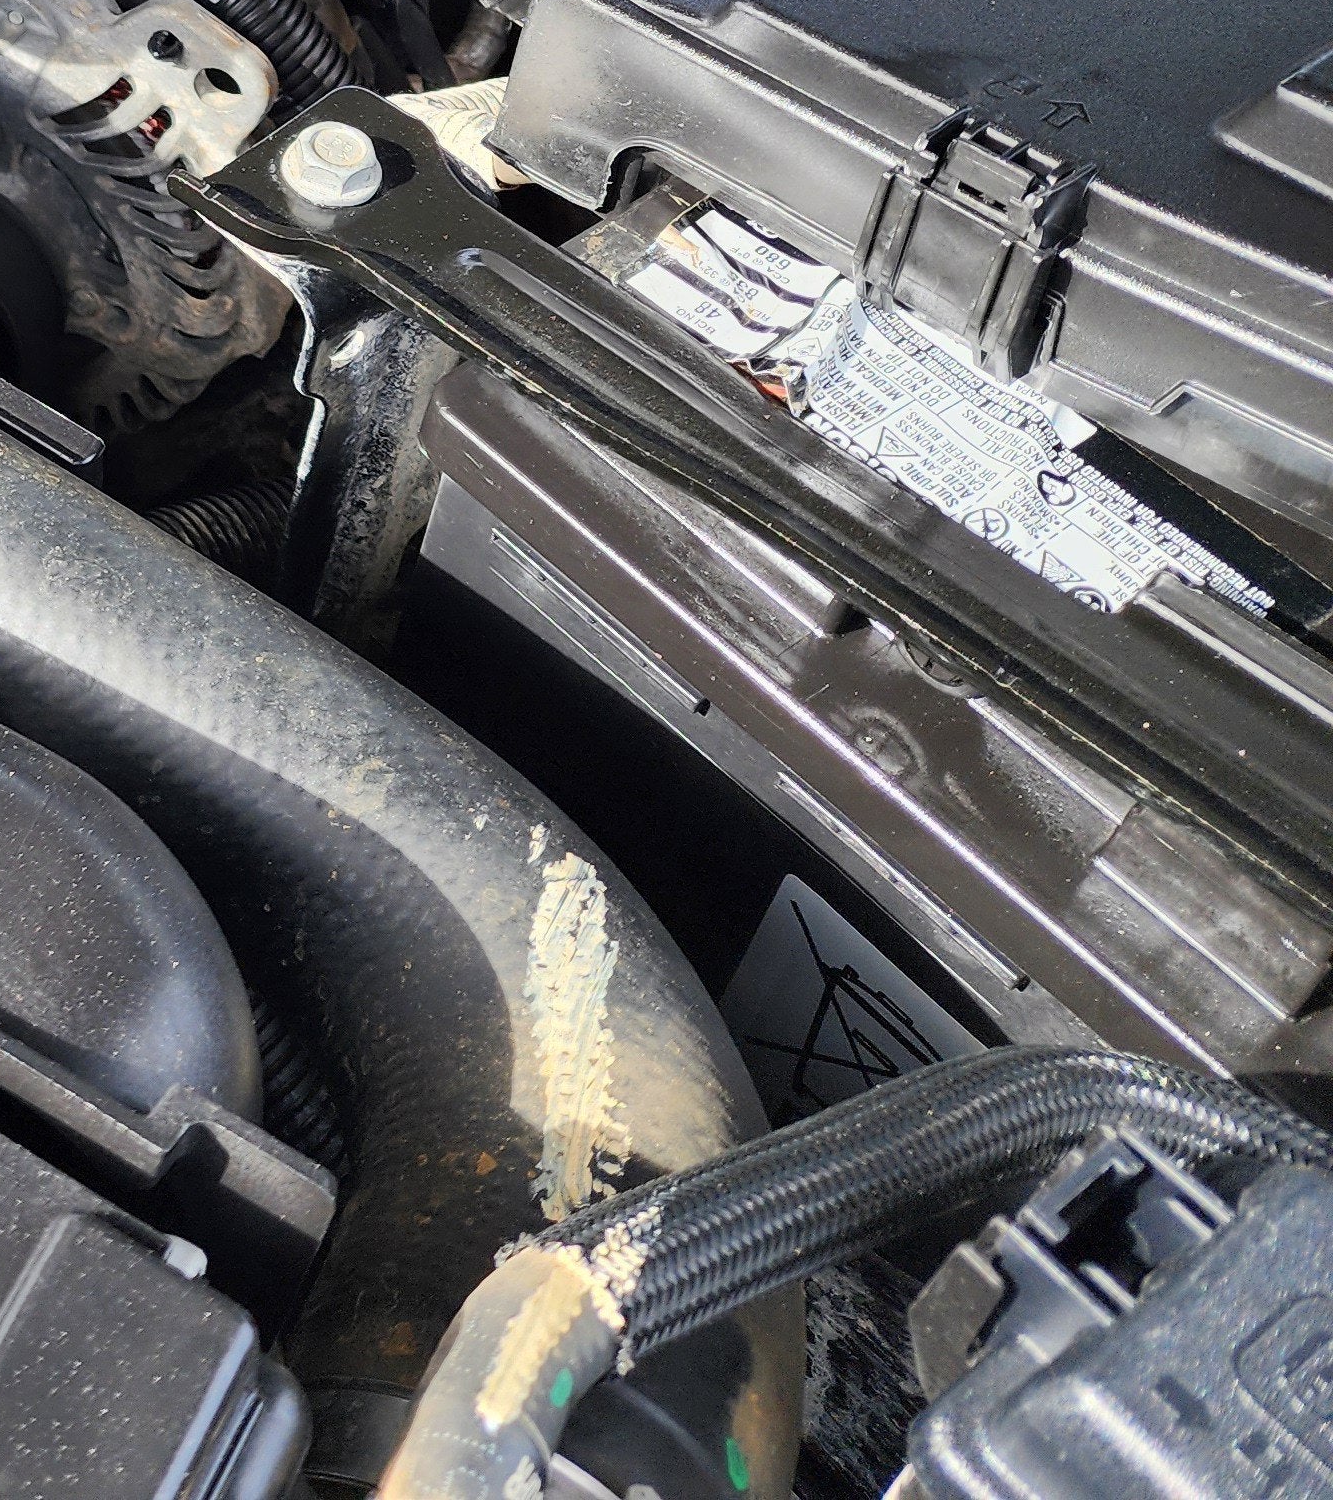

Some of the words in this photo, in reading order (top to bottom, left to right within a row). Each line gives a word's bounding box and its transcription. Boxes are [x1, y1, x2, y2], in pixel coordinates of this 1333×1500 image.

[753, 244, 791, 269] 680
[766, 265, 790, 283] CCA
[675, 305, 694, 320] NO.
[694, 299, 721, 318] 48
[694, 318, 715, 334] BCI
[807, 317, 832, 332] GET
[885, 348, 906, 366] TIP.
[899, 339, 918, 355] OR
[863, 349, 896, 374] OPEN
[926, 345, 984, 389] CHARGING
[849, 359, 904, 401] MEDICAL
[892, 372, 920, 392] NOT
[906, 365, 932, 385] NOT
[912, 349, 987, 406] DISASSEMBLE
[854, 390, 888, 415] WITH
[918, 390, 938, 407] DO
[930, 384, 950, 400] DO
[977, 383, 1026, 412] PROPER
[1015, 384, 1048, 405] NAPA
[819, 400, 862, 431] FLUSH
[979, 400, 1009, 419] NOT
[1002, 410, 1025, 427] DO
[905, 408, 943, 441] BURNS.
[960, 404, 1045, 465] INSTRUCTIONS.
[1018, 402, 1061, 447] FOLLOW
[894, 418, 952, 465] BLINDNESS
[979, 436, 1004, 454] ALL
[919, 456, 944, 476] CAN
[938, 439, 981, 471] SEVERE
[1000, 447, 1036, 472] READ
[1051, 457, 1071, 477] OR
[899, 461, 960, 508] SULFURIC
[940, 472, 974, 498] ACID
[947, 461, 986, 492] CAUSE
[978, 468, 997, 483] OR
[1078, 463, 1138, 509] INVERTED
[1067, 470, 1133, 520] EXPLOSION
[1132, 502, 1162, 526] FOR
[1085, 502, 1151, 556] CHILDREN.
[1092, 527, 1121, 550] THE
[1117, 550, 1141, 565] OF
[1157, 520, 1251, 592] RECOMMENDED
[1158, 539, 1181, 556] OF
[1175, 550, 1210, 577] RISK
[1204, 571, 1267, 619] WARNING:
[1242, 584, 1276, 609] NOT
